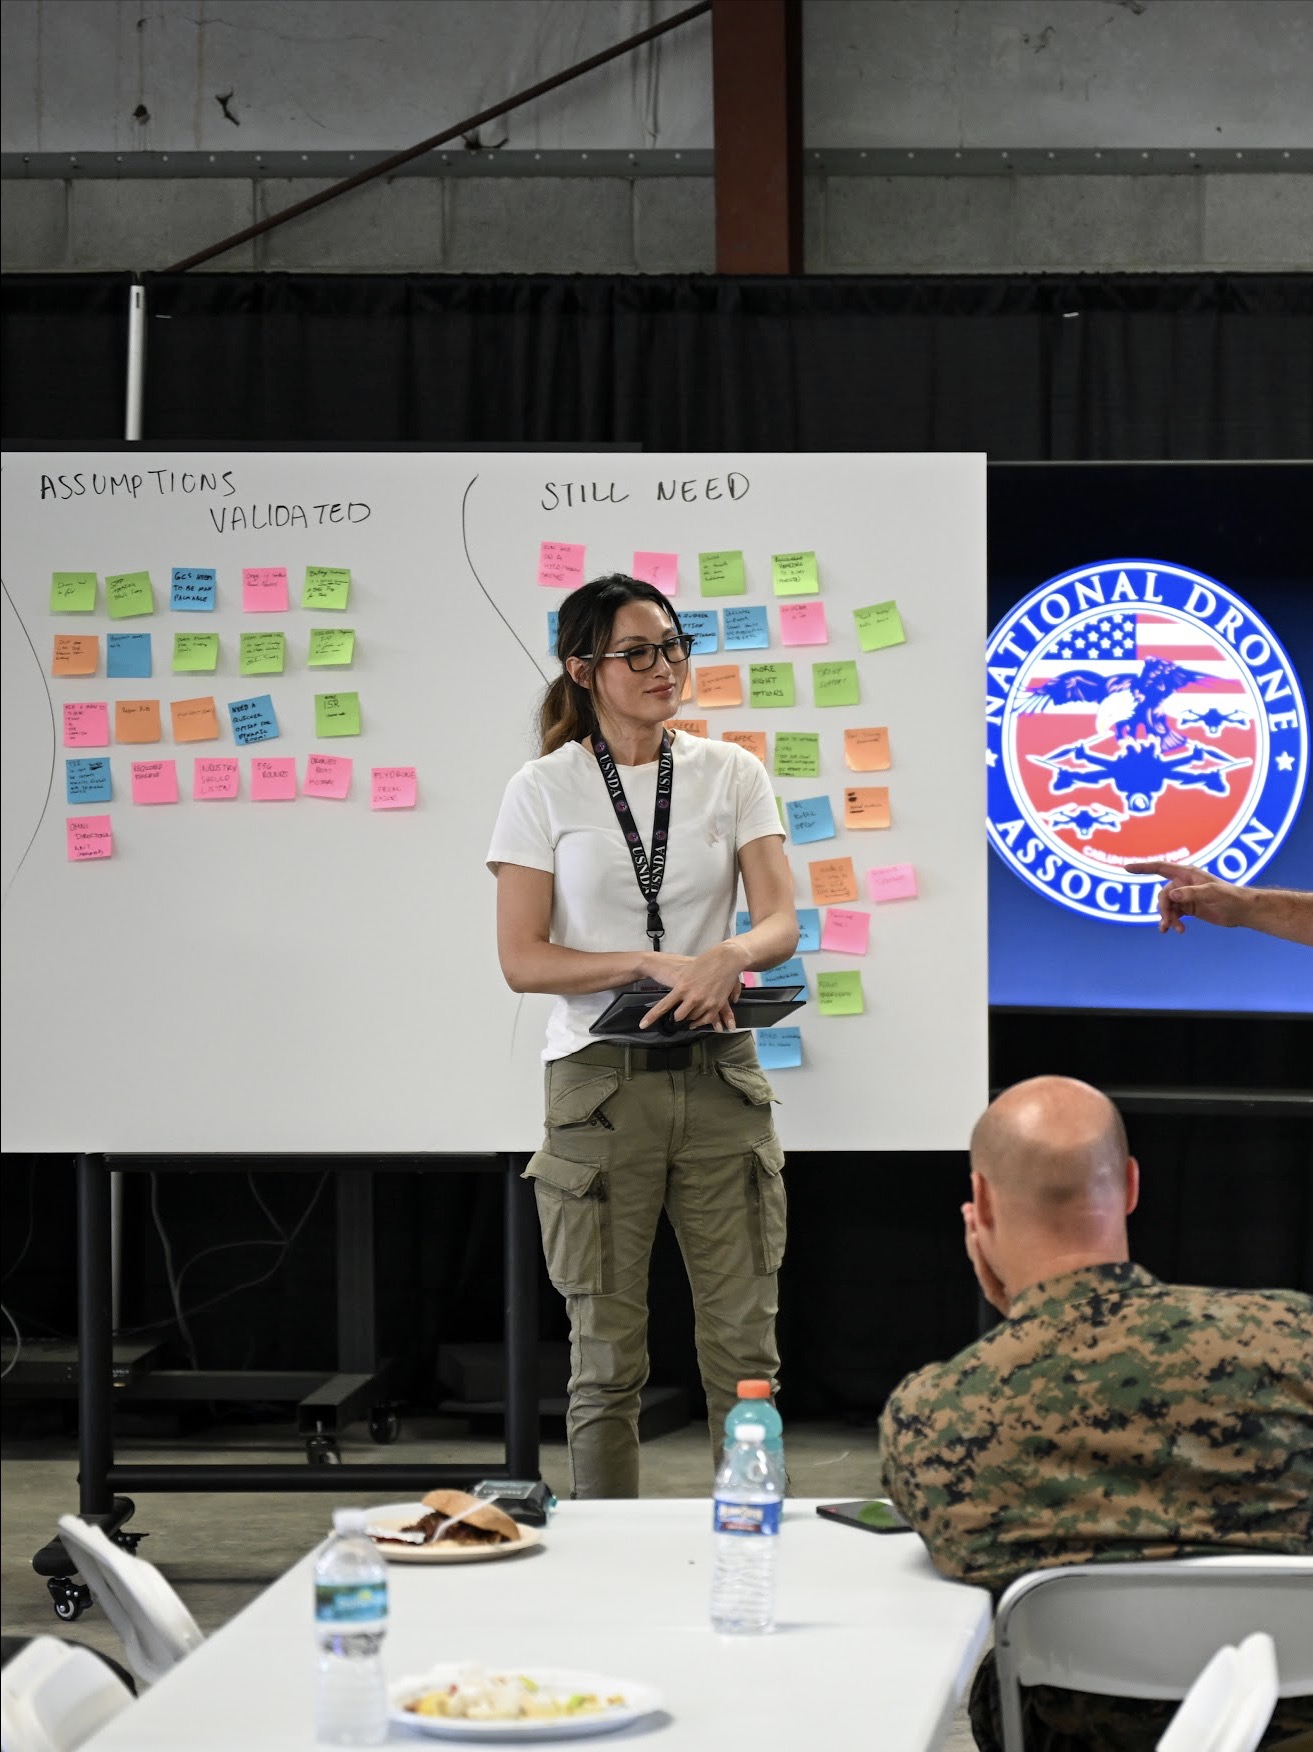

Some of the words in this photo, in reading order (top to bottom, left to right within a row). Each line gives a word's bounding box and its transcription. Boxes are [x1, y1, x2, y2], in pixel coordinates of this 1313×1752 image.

[40, 469, 237, 500] ASSUMPTIONS
[541, 481, 630, 511] STILL
[656, 471, 751, 503] NEED
[209, 502, 372, 534] VALIDATED
[751, 664, 777, 673] MORE
[986, 570, 1164, 728] NATIONAL
[1183, 582, 1299, 732] DRONE
[599, 753, 622, 798] USNDA
[658, 751, 672, 795] USNDA
[632, 846, 650, 895] USNDA
[650, 845, 666, 893] USNDA
[996, 817, 1276, 915] ASSOCION
